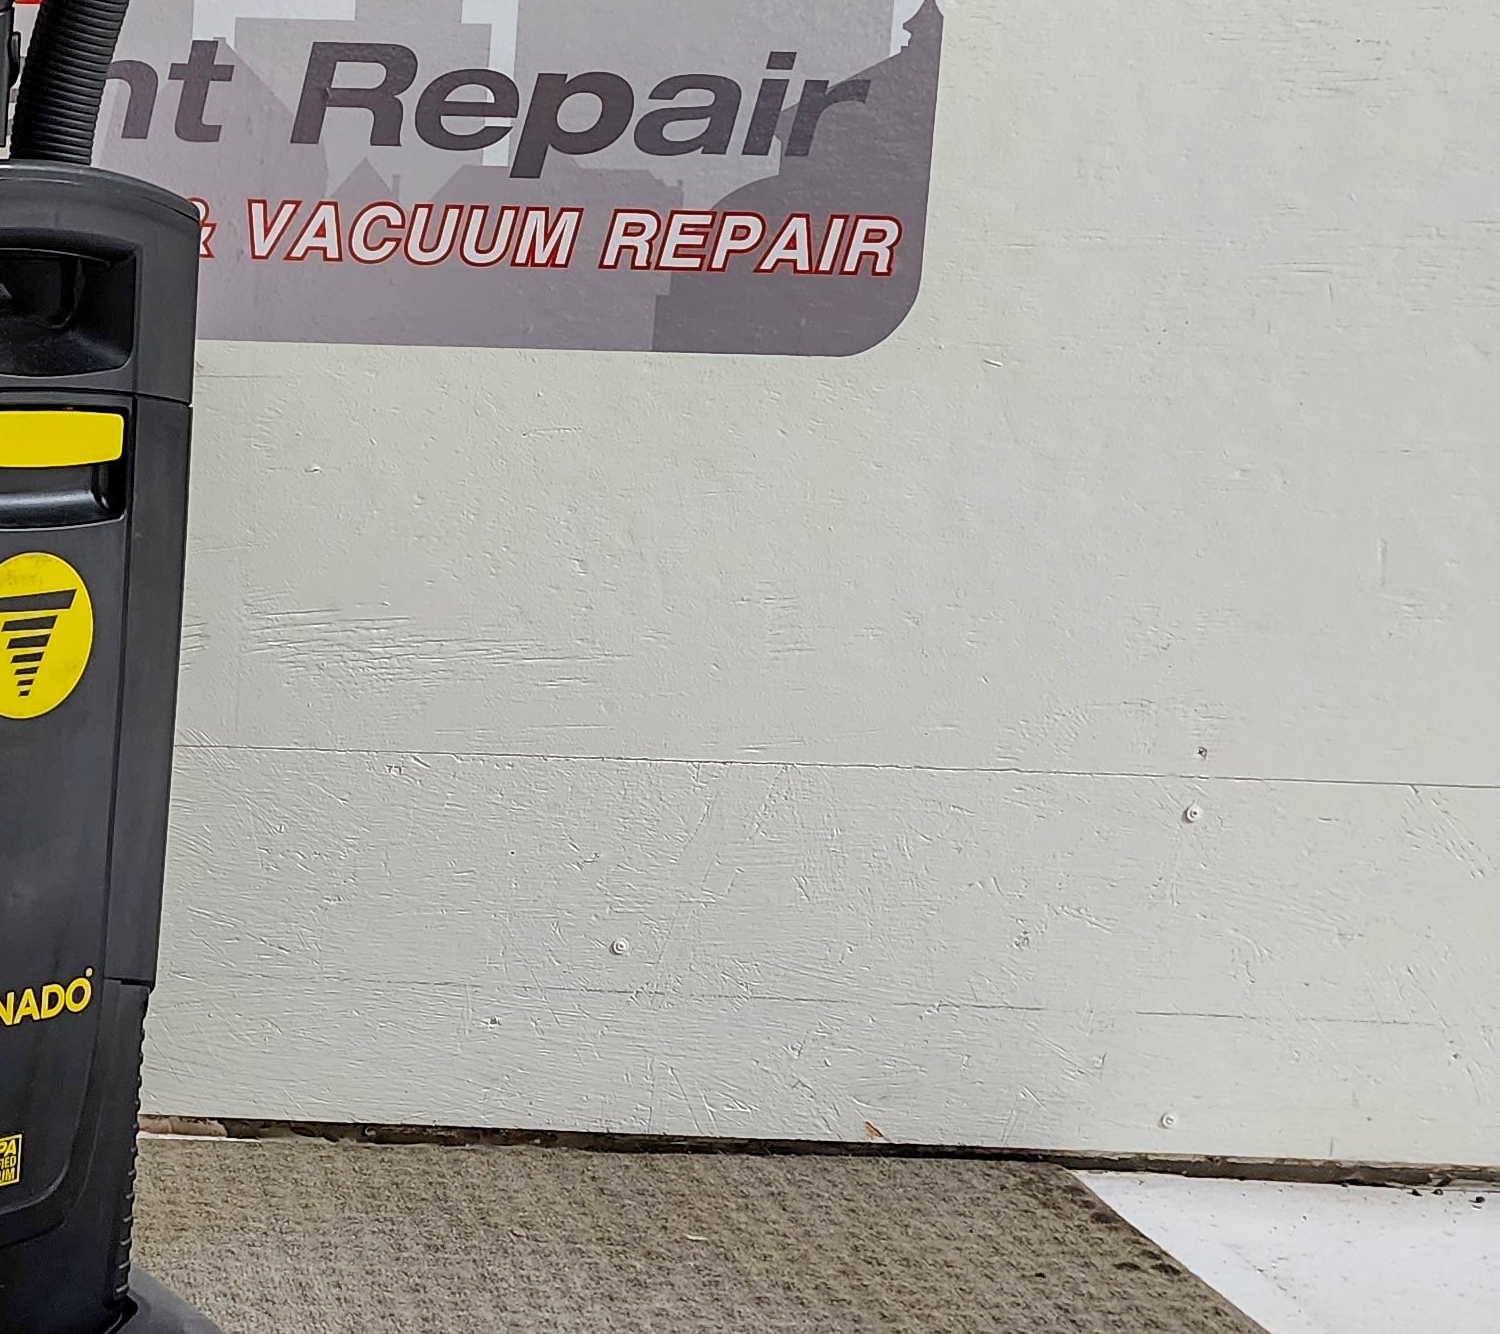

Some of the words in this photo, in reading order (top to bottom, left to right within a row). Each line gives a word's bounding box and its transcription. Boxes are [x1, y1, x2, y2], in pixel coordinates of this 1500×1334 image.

[289, 40, 870, 179] Repair
[246, 197, 584, 269] VACUUM
[598, 207, 903, 277] REPAIR
